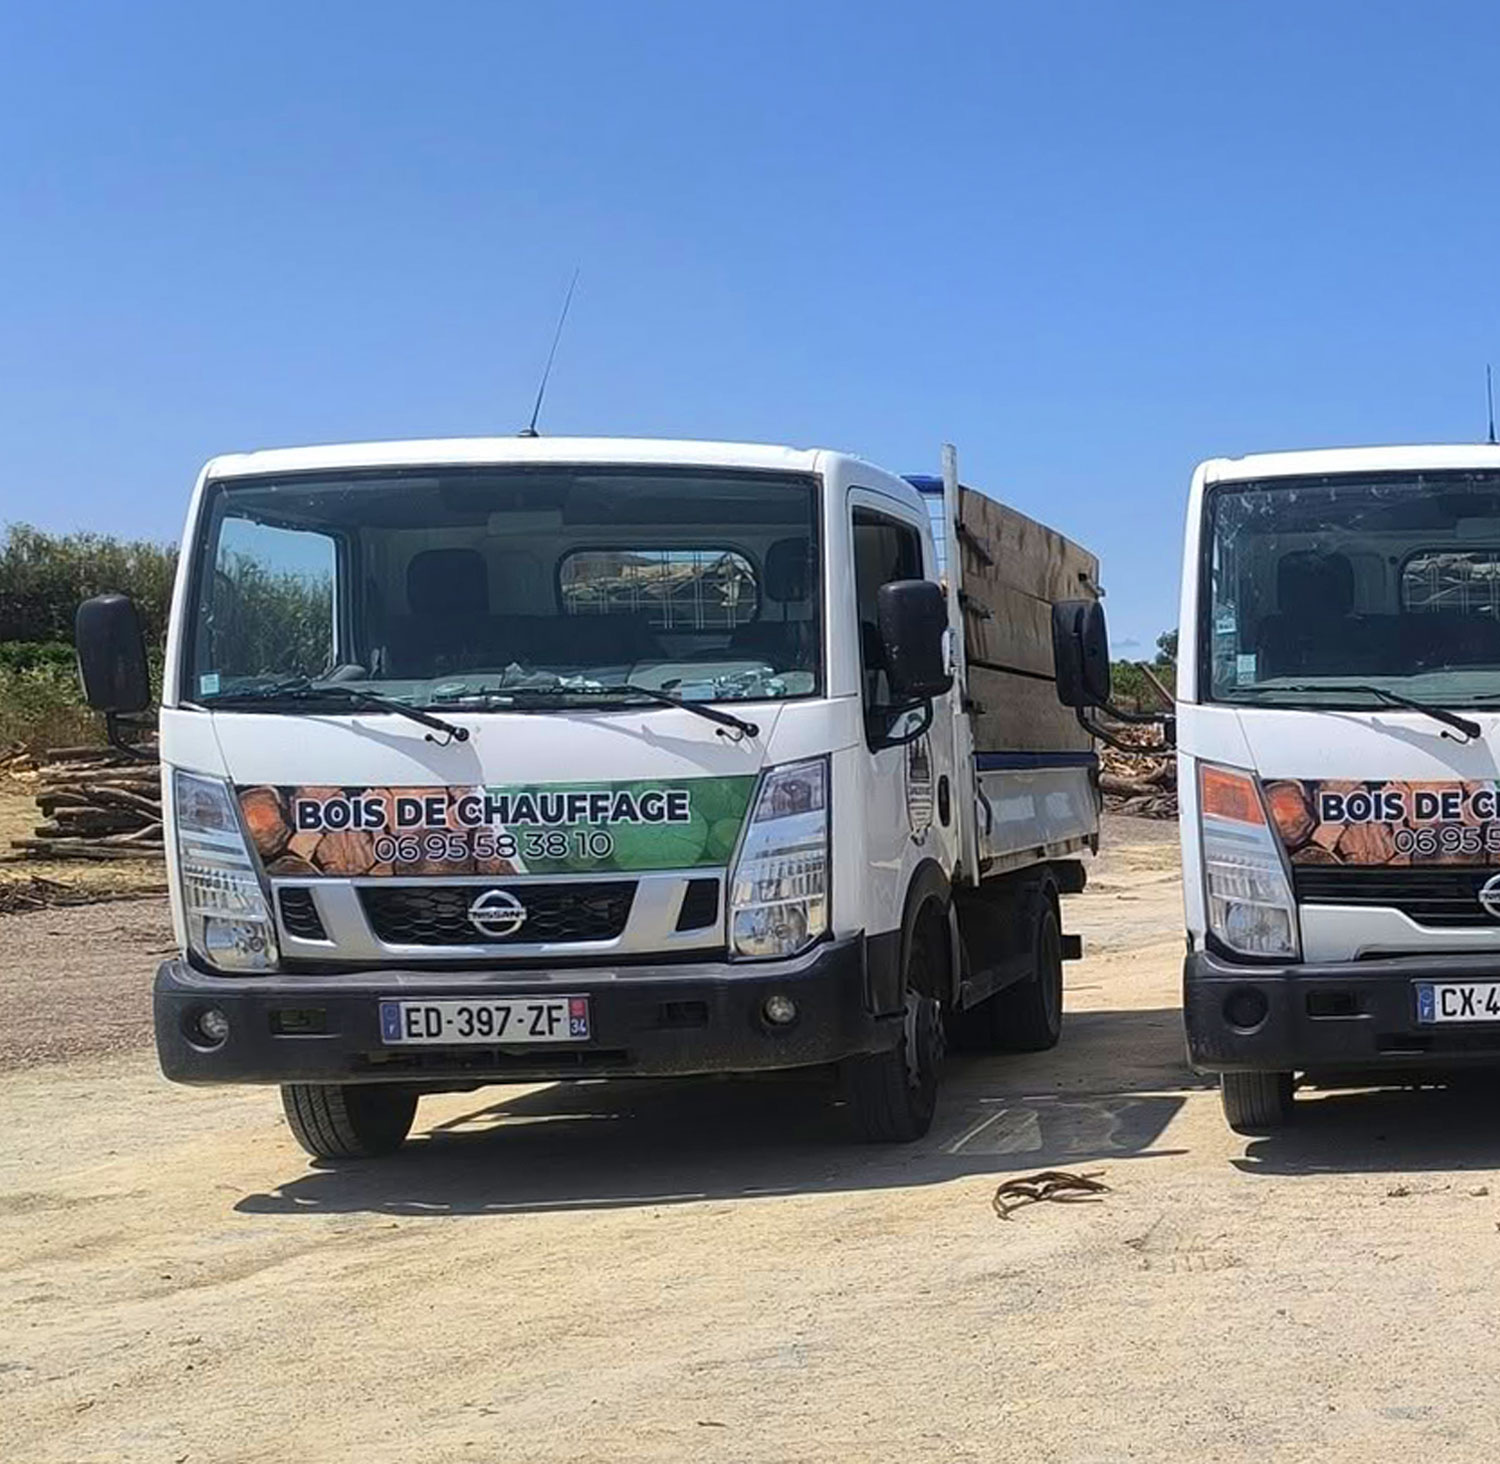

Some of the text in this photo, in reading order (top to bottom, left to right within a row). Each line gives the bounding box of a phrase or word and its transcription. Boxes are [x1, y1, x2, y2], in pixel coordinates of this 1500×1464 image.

[297, 790, 691, 832] BOIS DE CHAUFFAGE
[1320, 791, 1405, 824] BOIS
[1413, 790, 1462, 822] DE
[374, 830, 614, 863] 06 95 58 38 10
[1394, 828, 1437, 854] 06
[1441, 827, 1483, 852] 95
[405, 1005, 564, 1038] ED-397-ZF
[571, 1018, 587, 1034] 34
